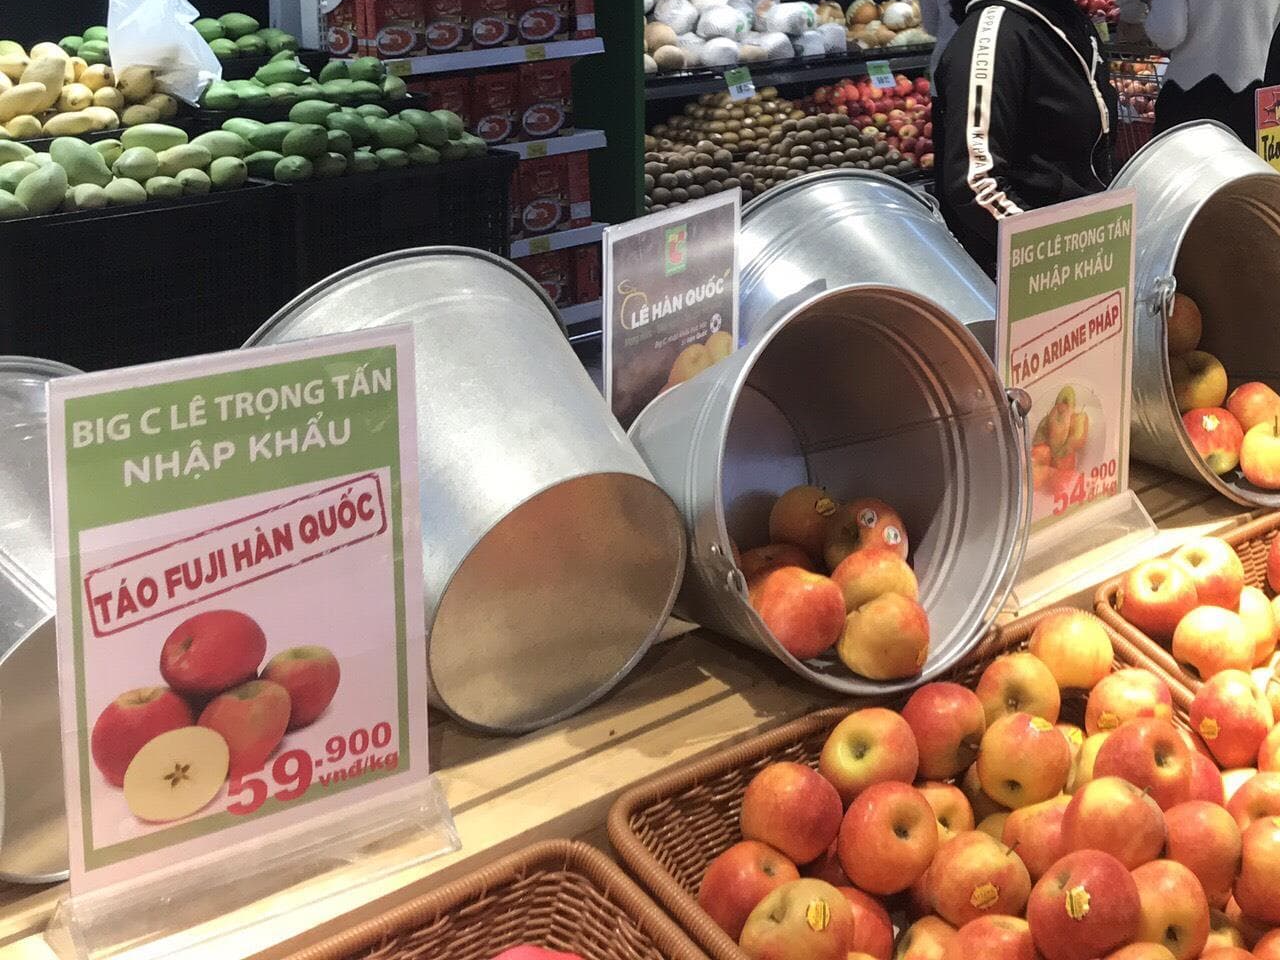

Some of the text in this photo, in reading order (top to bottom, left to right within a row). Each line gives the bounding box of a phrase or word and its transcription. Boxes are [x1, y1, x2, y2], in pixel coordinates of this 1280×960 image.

[1011, 215, 1131, 268] BIG C LÊ TRỌNG TẤN
[1028, 247, 1114, 295] NHẬP KHẨU
[631, 273, 725, 330] LÊ HÀN QUỐC
[1013, 303, 1119, 385] TÁO ARIANE PHÁP
[71, 365, 394, 450] BIG C LÊ TRỌNG TẤN
[122, 415, 353, 488] NHẬP KHẨU
[92, 487, 377, 627] TÁO FUJI HÀN QUỐC
[318, 751, 399, 791] vnd/kg
